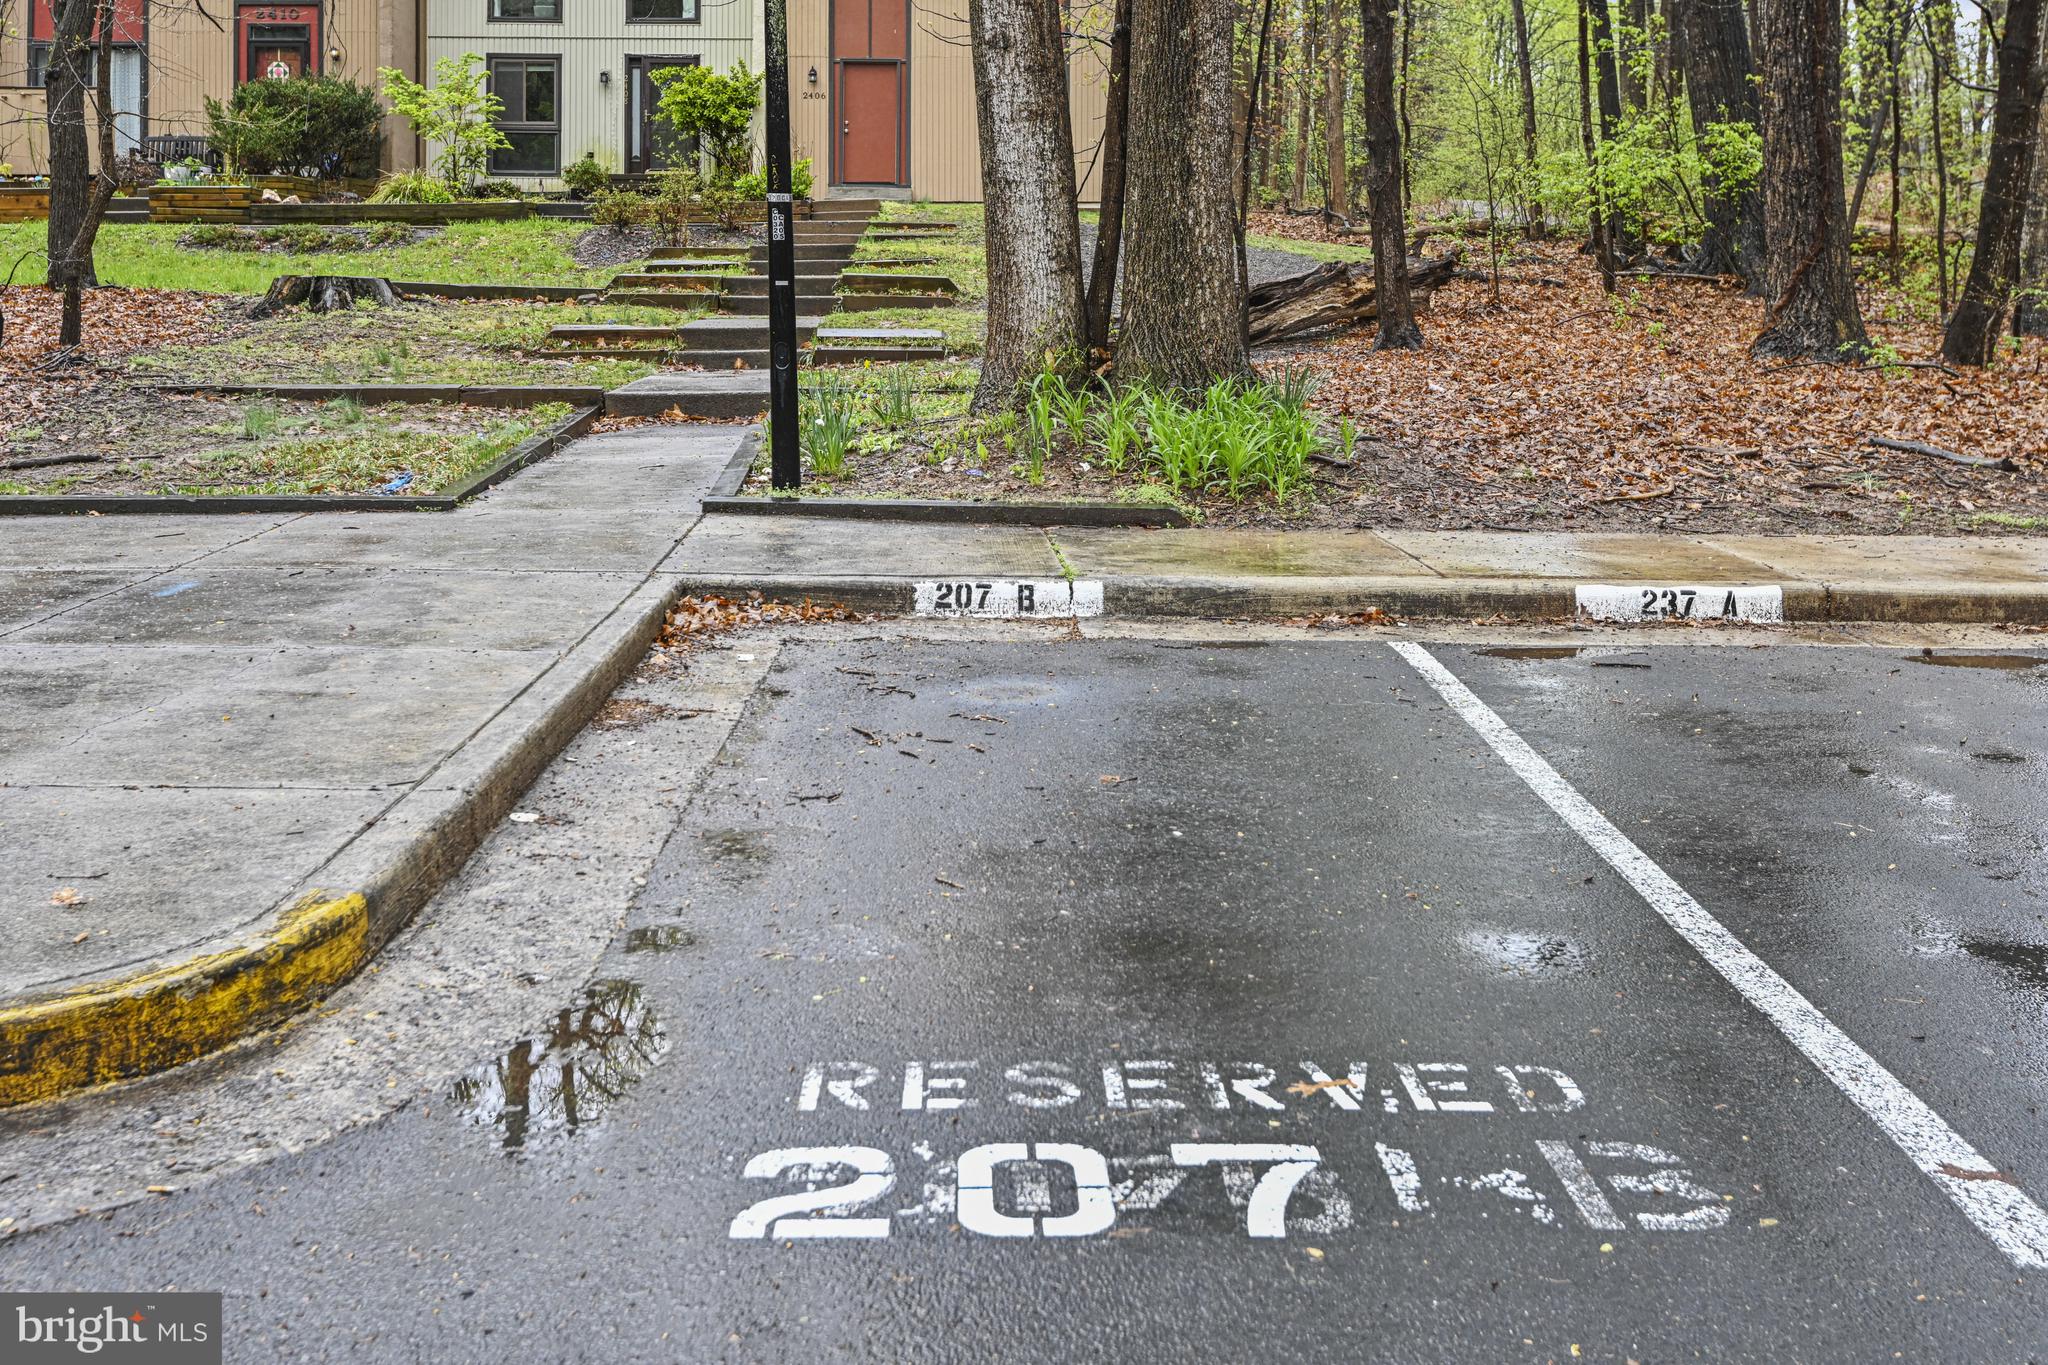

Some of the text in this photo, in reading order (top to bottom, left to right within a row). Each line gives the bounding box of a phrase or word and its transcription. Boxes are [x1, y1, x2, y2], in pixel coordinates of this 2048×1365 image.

[256, 7, 300, 20] 2410
[802, 91, 826, 100] 2406
[934, 582, 1035, 612] 207 B
[1641, 589, 1738, 617] 237 A
[798, 1059, 1587, 1112] RESERVED
[729, 1142, 1321, 1239] 207
